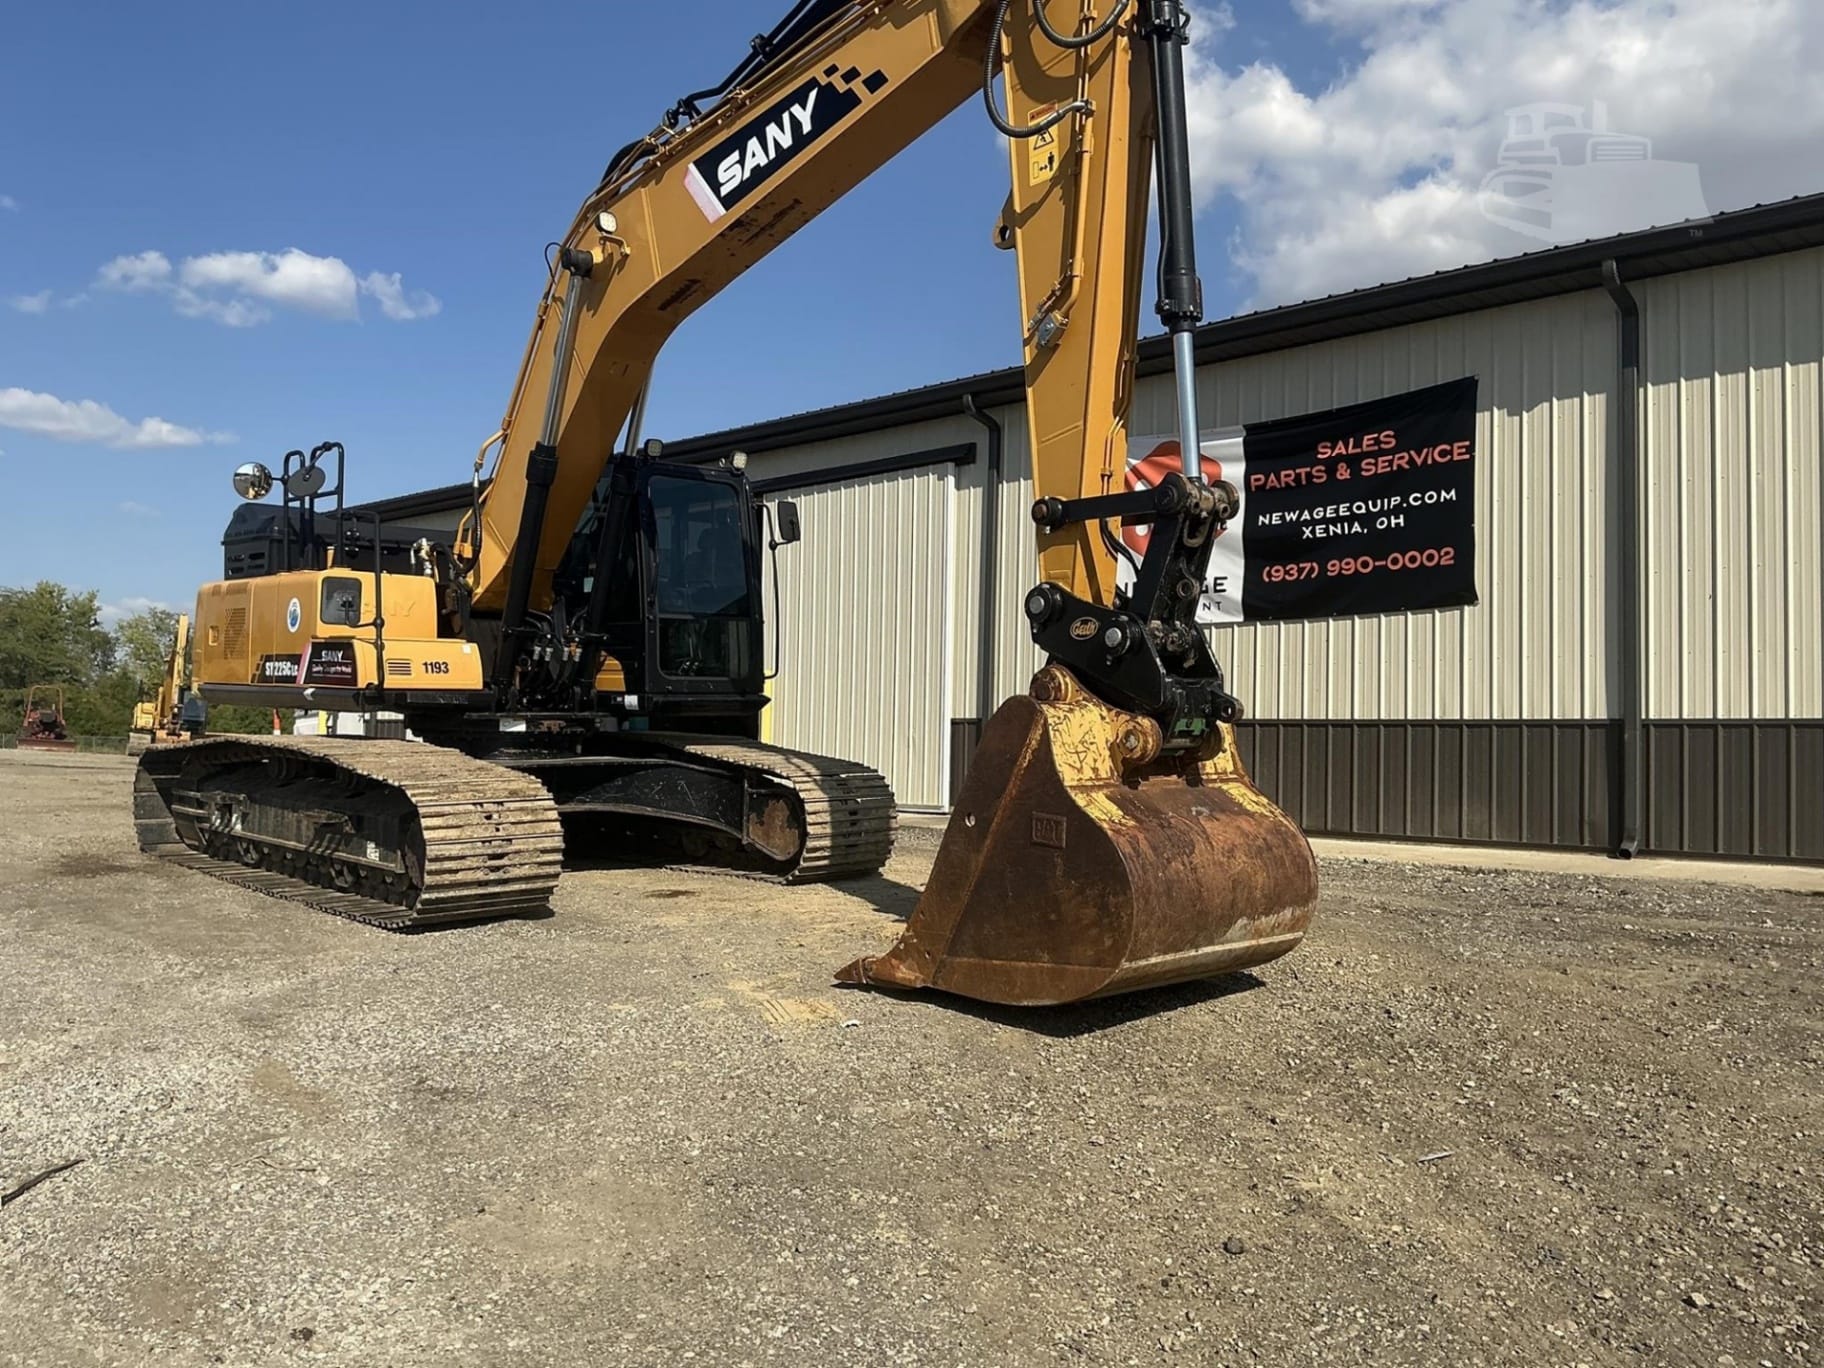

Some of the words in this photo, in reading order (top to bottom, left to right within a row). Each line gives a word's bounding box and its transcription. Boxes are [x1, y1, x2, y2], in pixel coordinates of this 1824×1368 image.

[717, 87, 819, 198] SANY
[1316, 430, 1397, 459] SALES
[1249, 464, 1328, 492] PARTS
[1335, 461, 1352, 480] &
[1360, 440, 1471, 477] SERVICE
[1257, 487, 1458, 527] NEWAGEEQUIP.COM
[1302, 521, 1368, 540] XENIA,
[1375, 513, 1406, 530] OH
[1261, 562, 1320, 584] (937)
[1326, 546, 1456, 577] 990-0002
[421, 661, 450, 675] 1193
